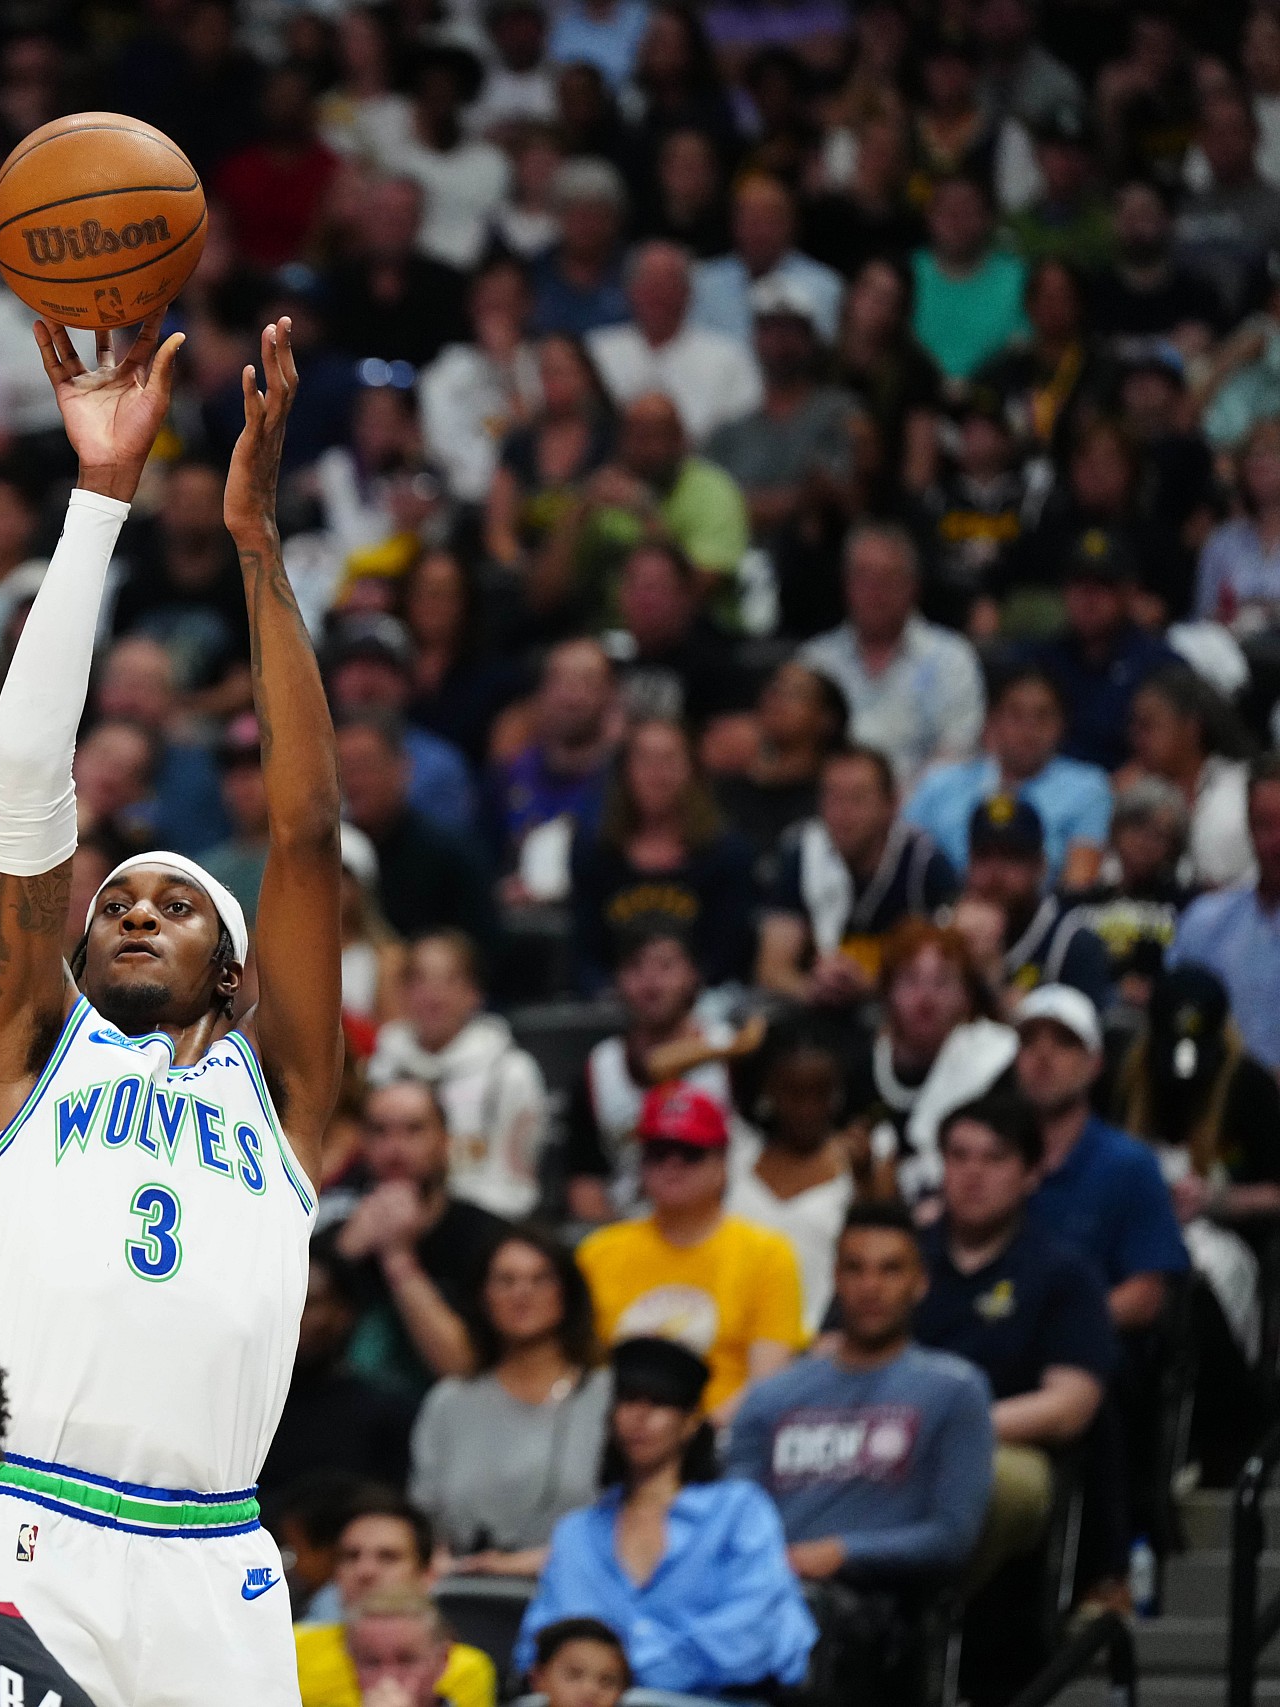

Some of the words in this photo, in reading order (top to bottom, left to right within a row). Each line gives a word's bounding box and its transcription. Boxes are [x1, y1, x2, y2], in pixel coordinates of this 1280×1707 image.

[22, 215, 170, 266] Wilson
[54, 1073, 266, 1196] WOLVES
[125, 1182, 182, 1283] 3
[246, 1567, 272, 1586] NIKE
